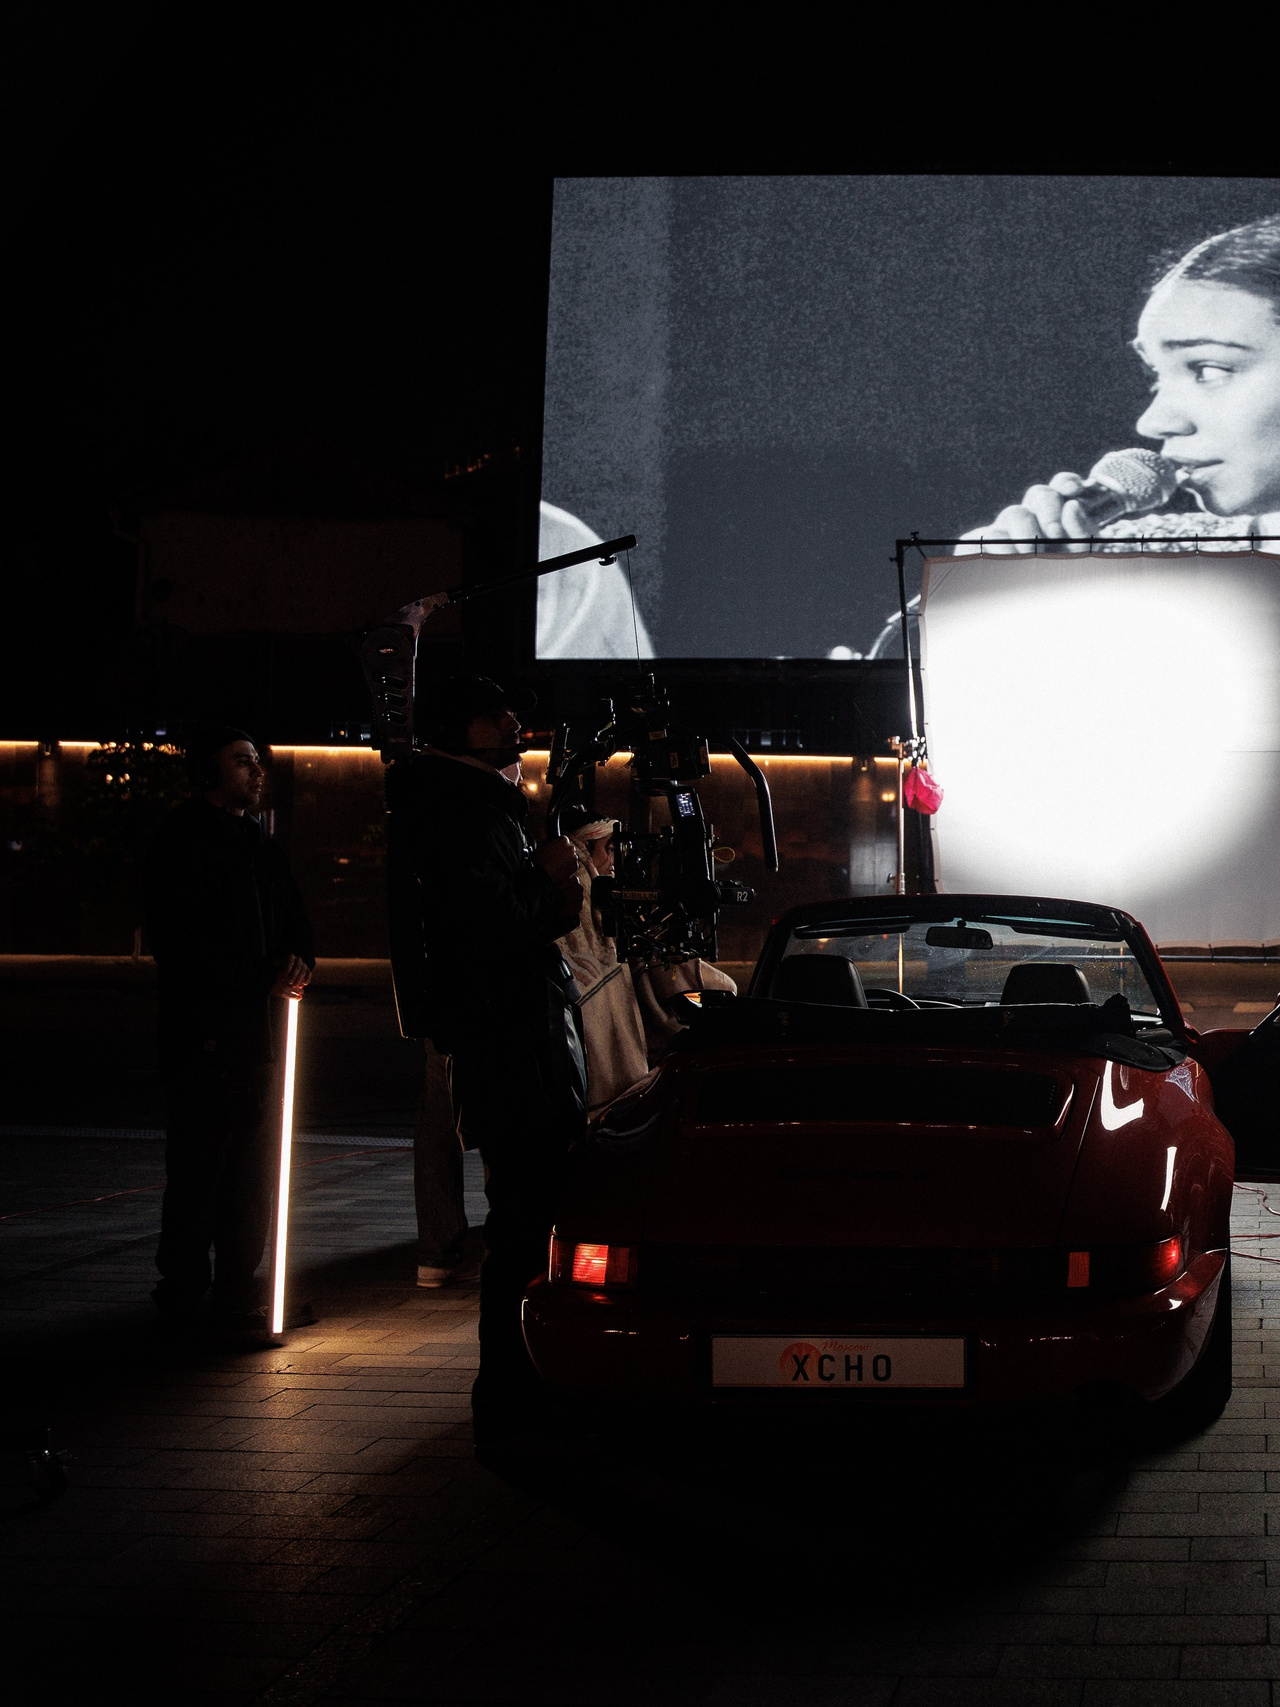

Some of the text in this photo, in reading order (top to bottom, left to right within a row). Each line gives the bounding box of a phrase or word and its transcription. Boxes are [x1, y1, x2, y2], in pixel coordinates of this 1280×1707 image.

[736, 891, 748, 902] R2
[821, 1340, 870, 1351] Moscow
[792, 1354, 892, 1381] XCHO
